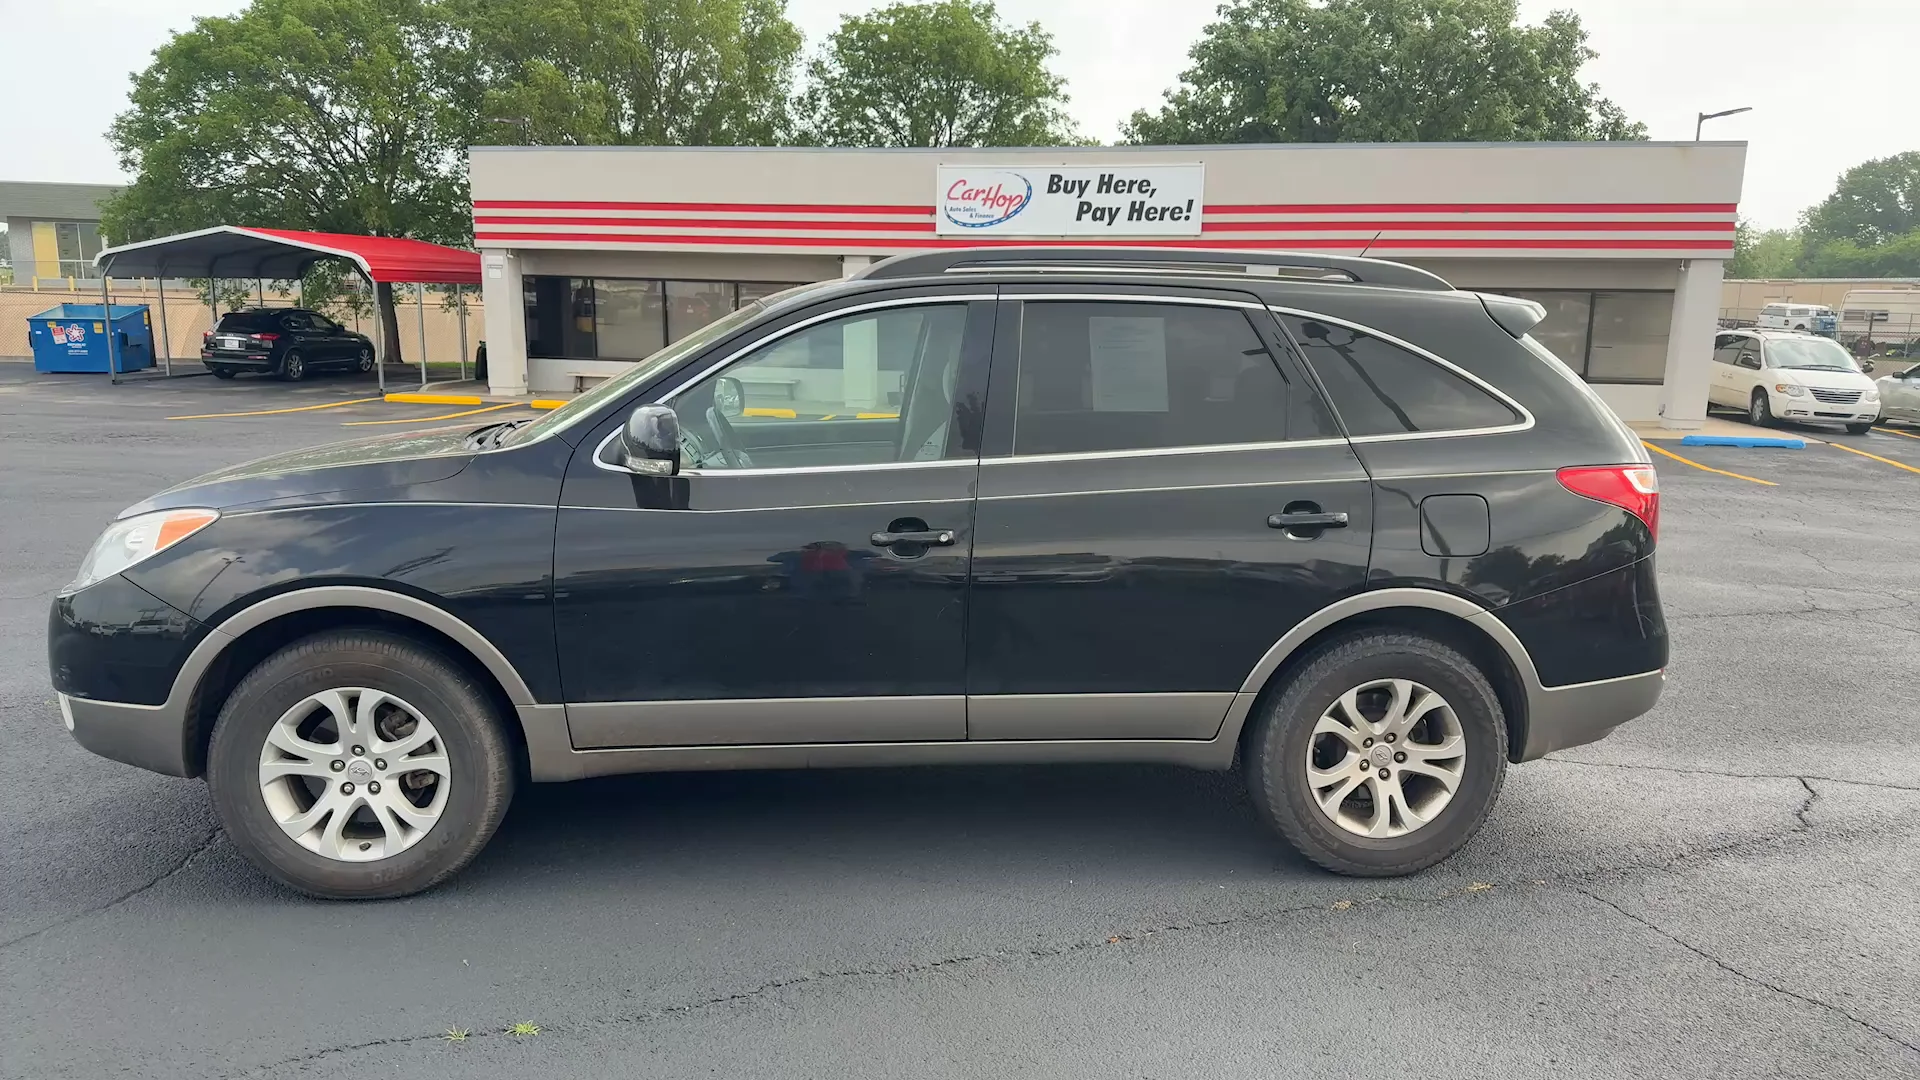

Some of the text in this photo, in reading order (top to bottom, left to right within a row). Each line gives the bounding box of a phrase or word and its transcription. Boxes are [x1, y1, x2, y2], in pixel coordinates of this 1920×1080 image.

[1046, 173, 1158, 199] Buy Here,
[1075, 198, 1195, 227] Pay Here!
